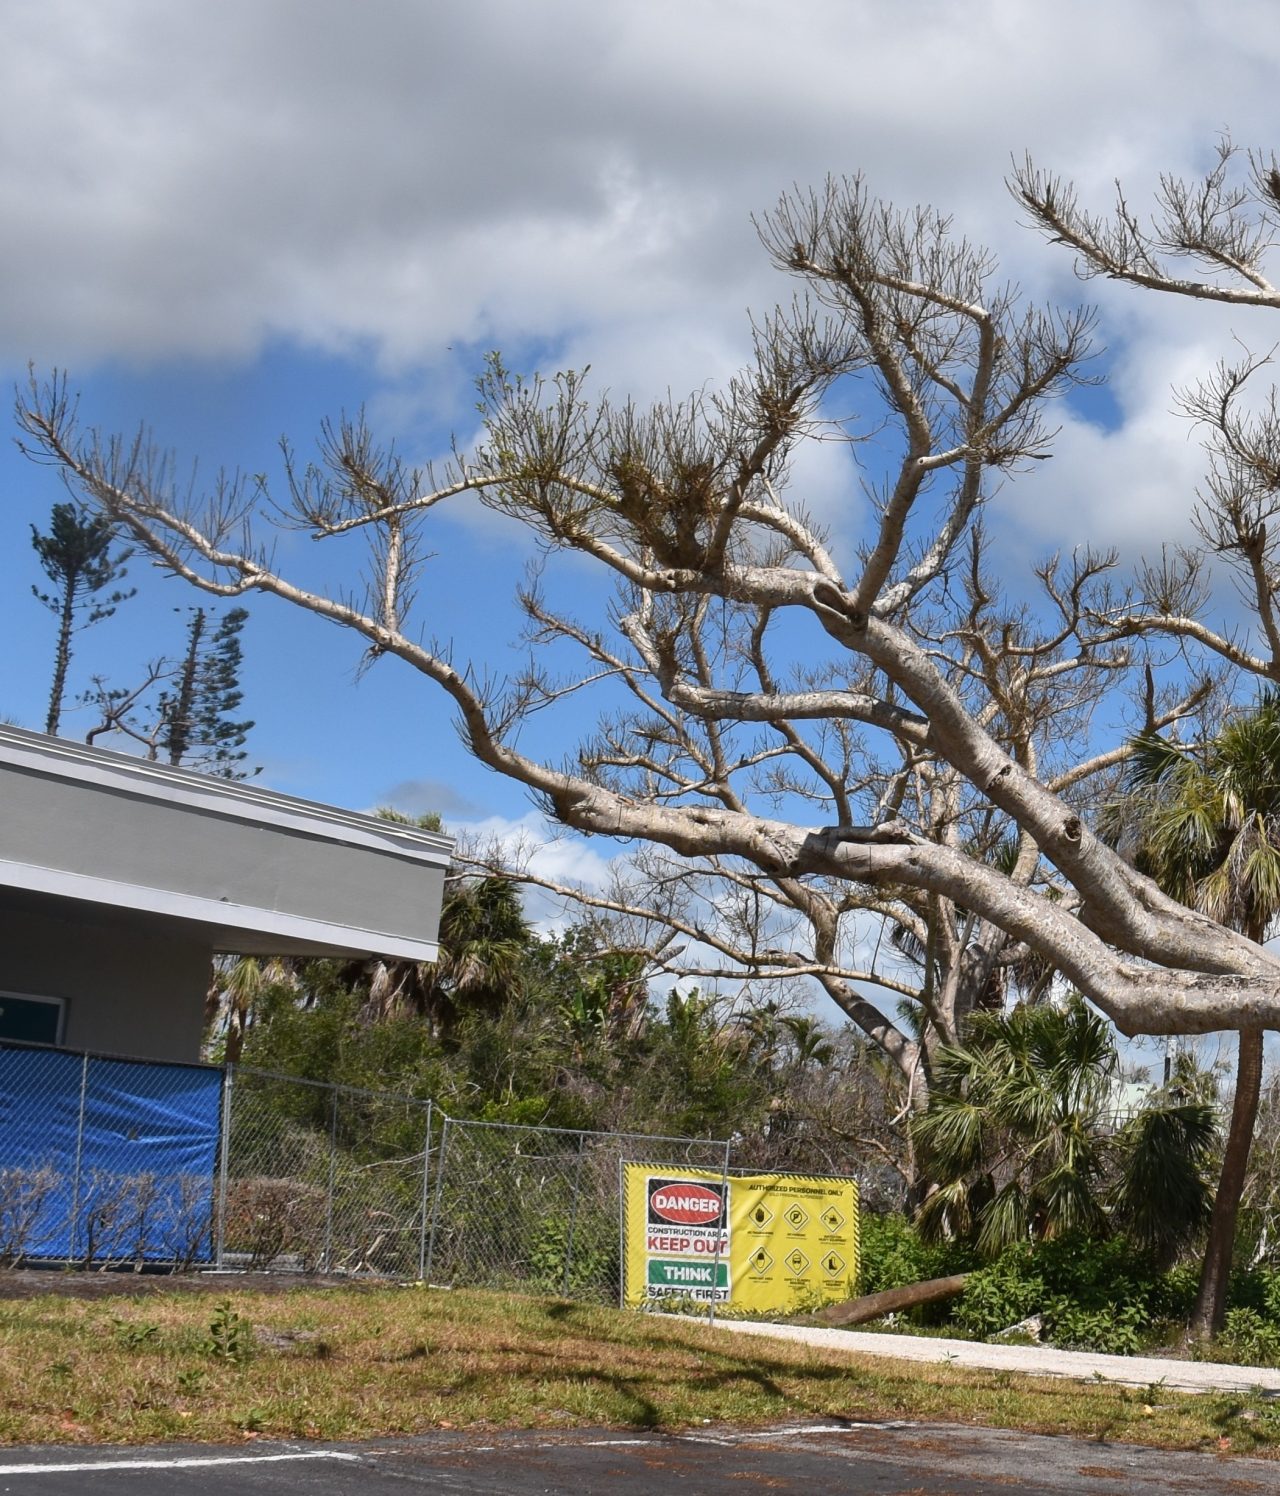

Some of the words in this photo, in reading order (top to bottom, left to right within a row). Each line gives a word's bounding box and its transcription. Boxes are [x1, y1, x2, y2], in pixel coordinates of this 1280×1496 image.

[749, 1185, 787, 1193] AUTHORIZED
[789, 1186, 827, 1195] PERSONNEL
[828, 1189, 843, 1197] ONLY
[655, 1195, 719, 1212] DANGER
[648, 1227, 705, 1236] CONSTRUCTION
[707, 1230, 728, 1238] ARA
[648, 1236, 690, 1251] KEEP
[694, 1240, 727, 1253] OUT
[663, 1266, 712, 1281] THINK
[695, 1289, 729, 1300] FIRST
